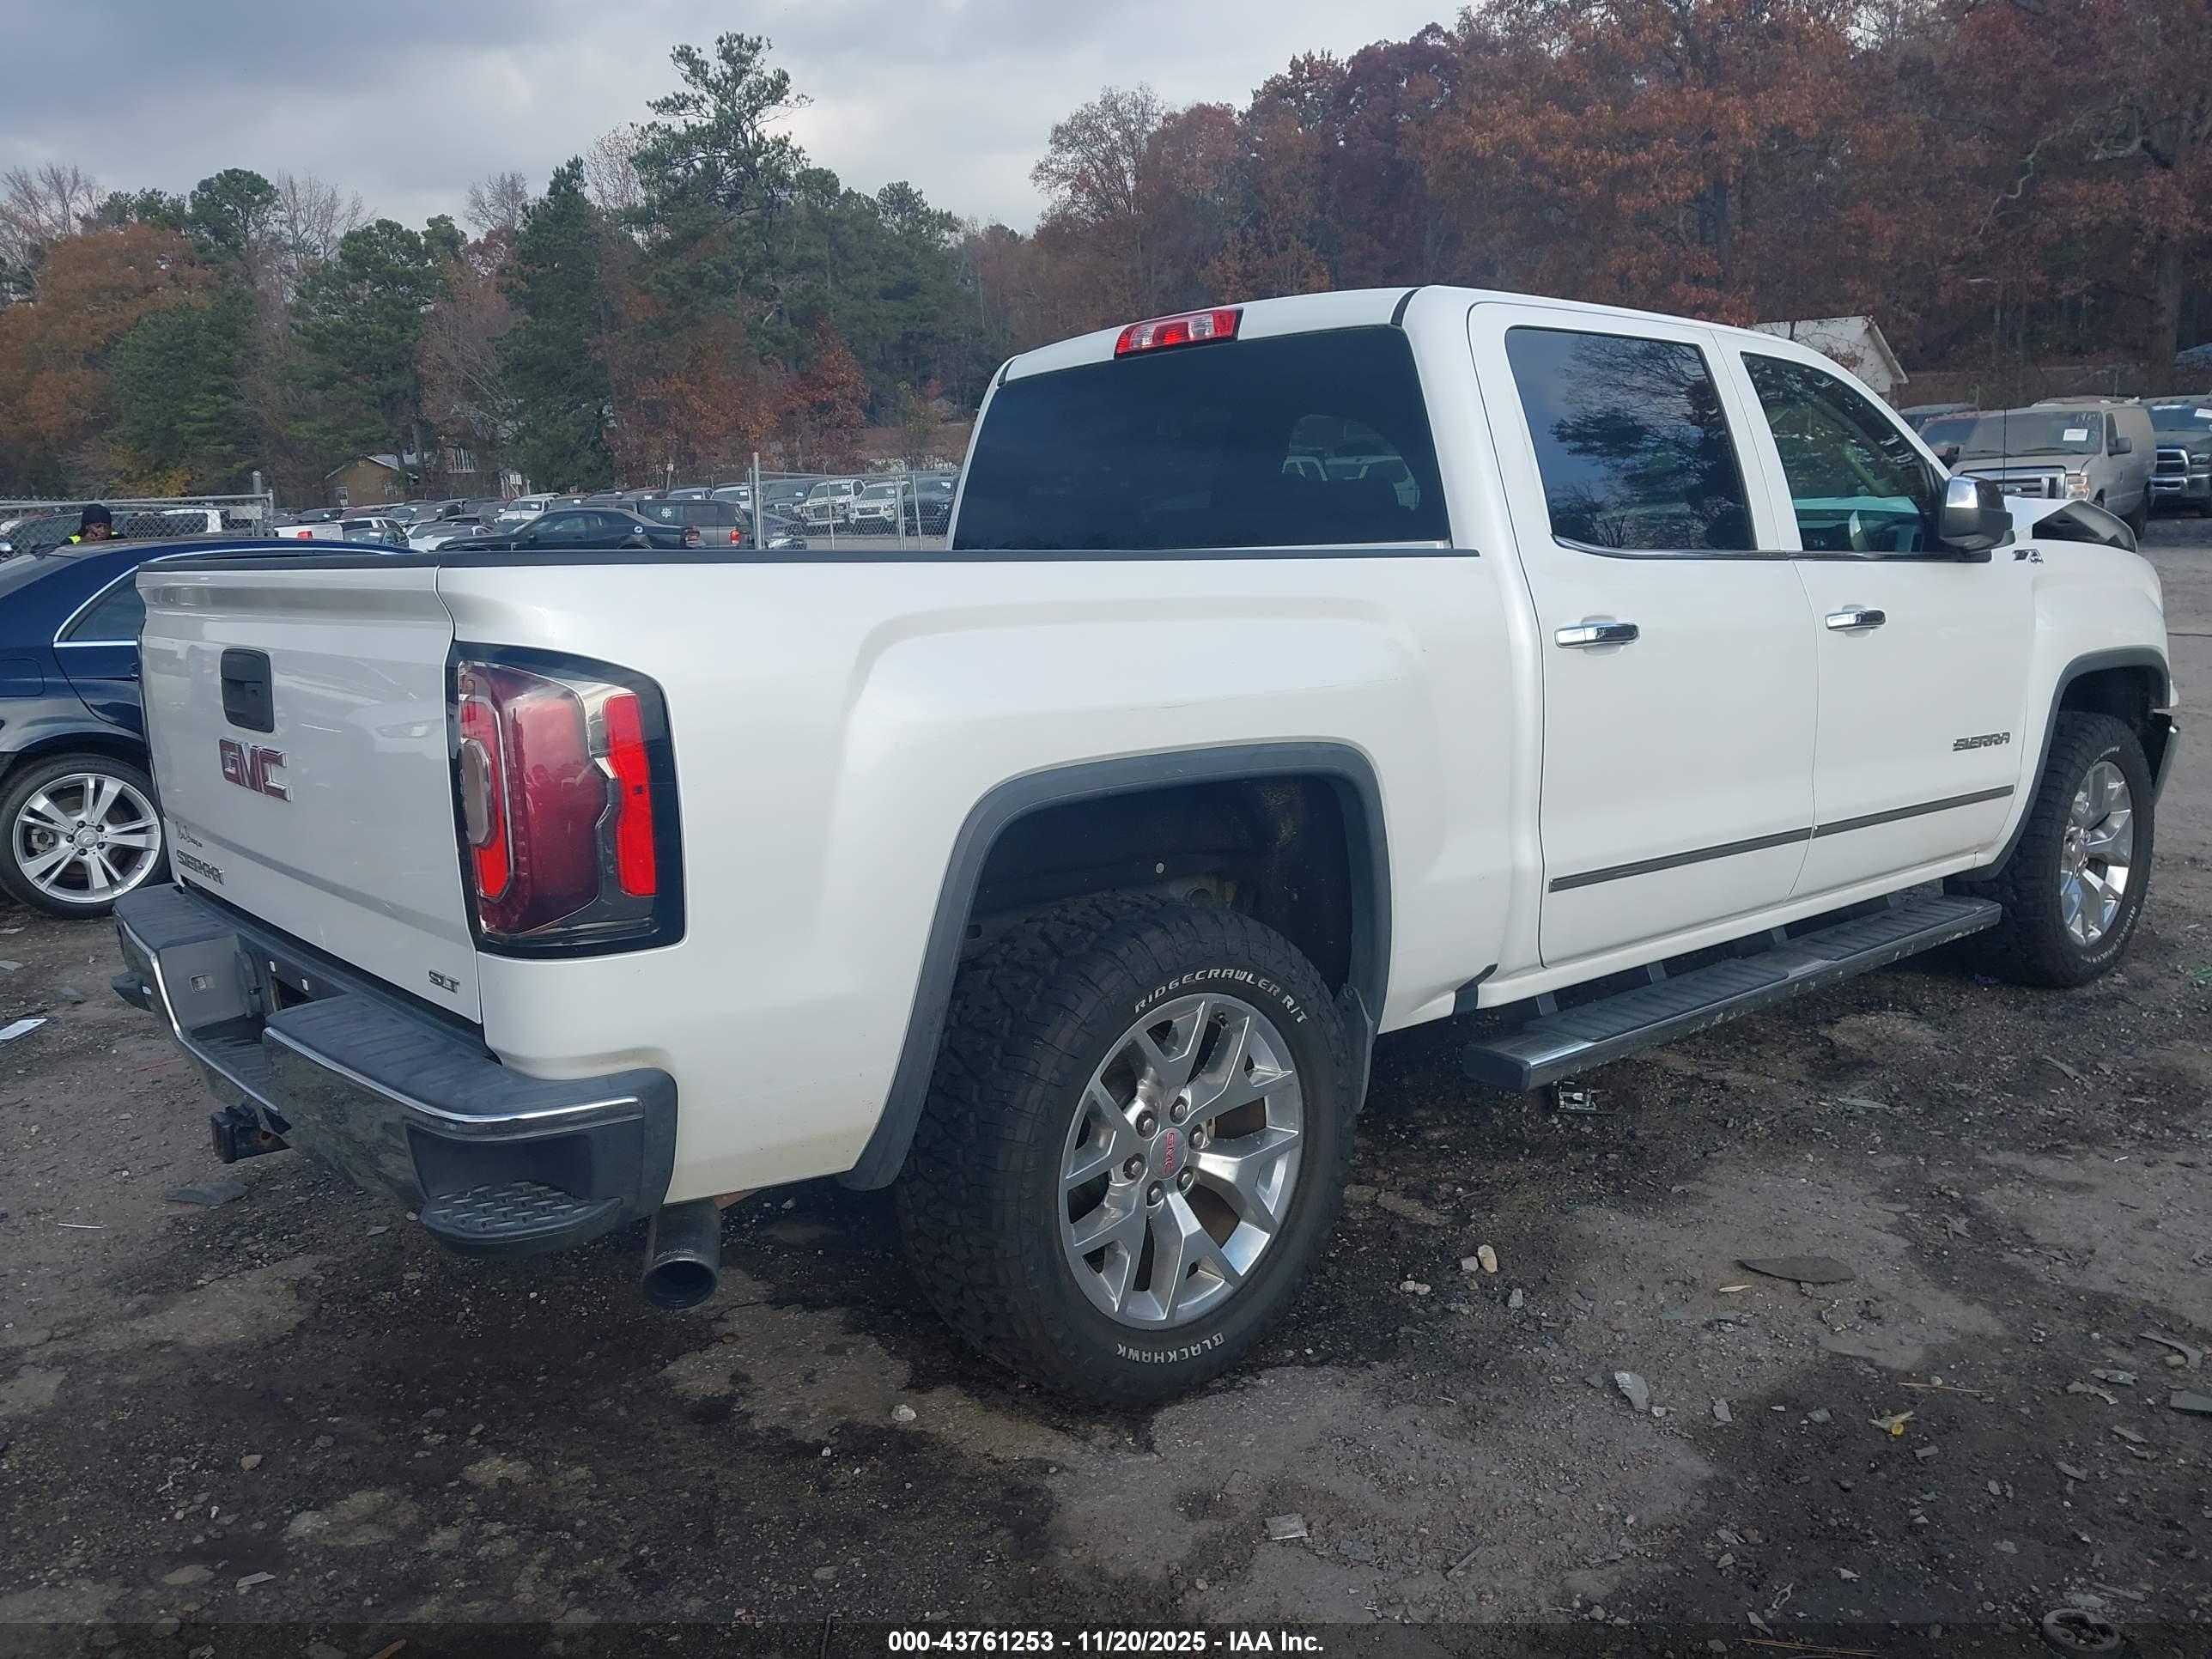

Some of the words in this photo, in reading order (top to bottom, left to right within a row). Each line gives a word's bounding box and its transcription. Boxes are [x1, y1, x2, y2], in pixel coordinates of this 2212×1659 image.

[1953, 732, 2010, 751] SIERRA
[219, 738, 291, 802] GMC
[176, 849, 225, 885] SIERRA
[428, 969, 460, 994] SLT
[1133, 969, 1280, 1013] RIDGECRAWLER
[1281, 994, 1309, 1024] R/T
[1164, 1132, 1175, 1174] GMC
[1116, 1332, 1224, 1364] BLACKHAWK
